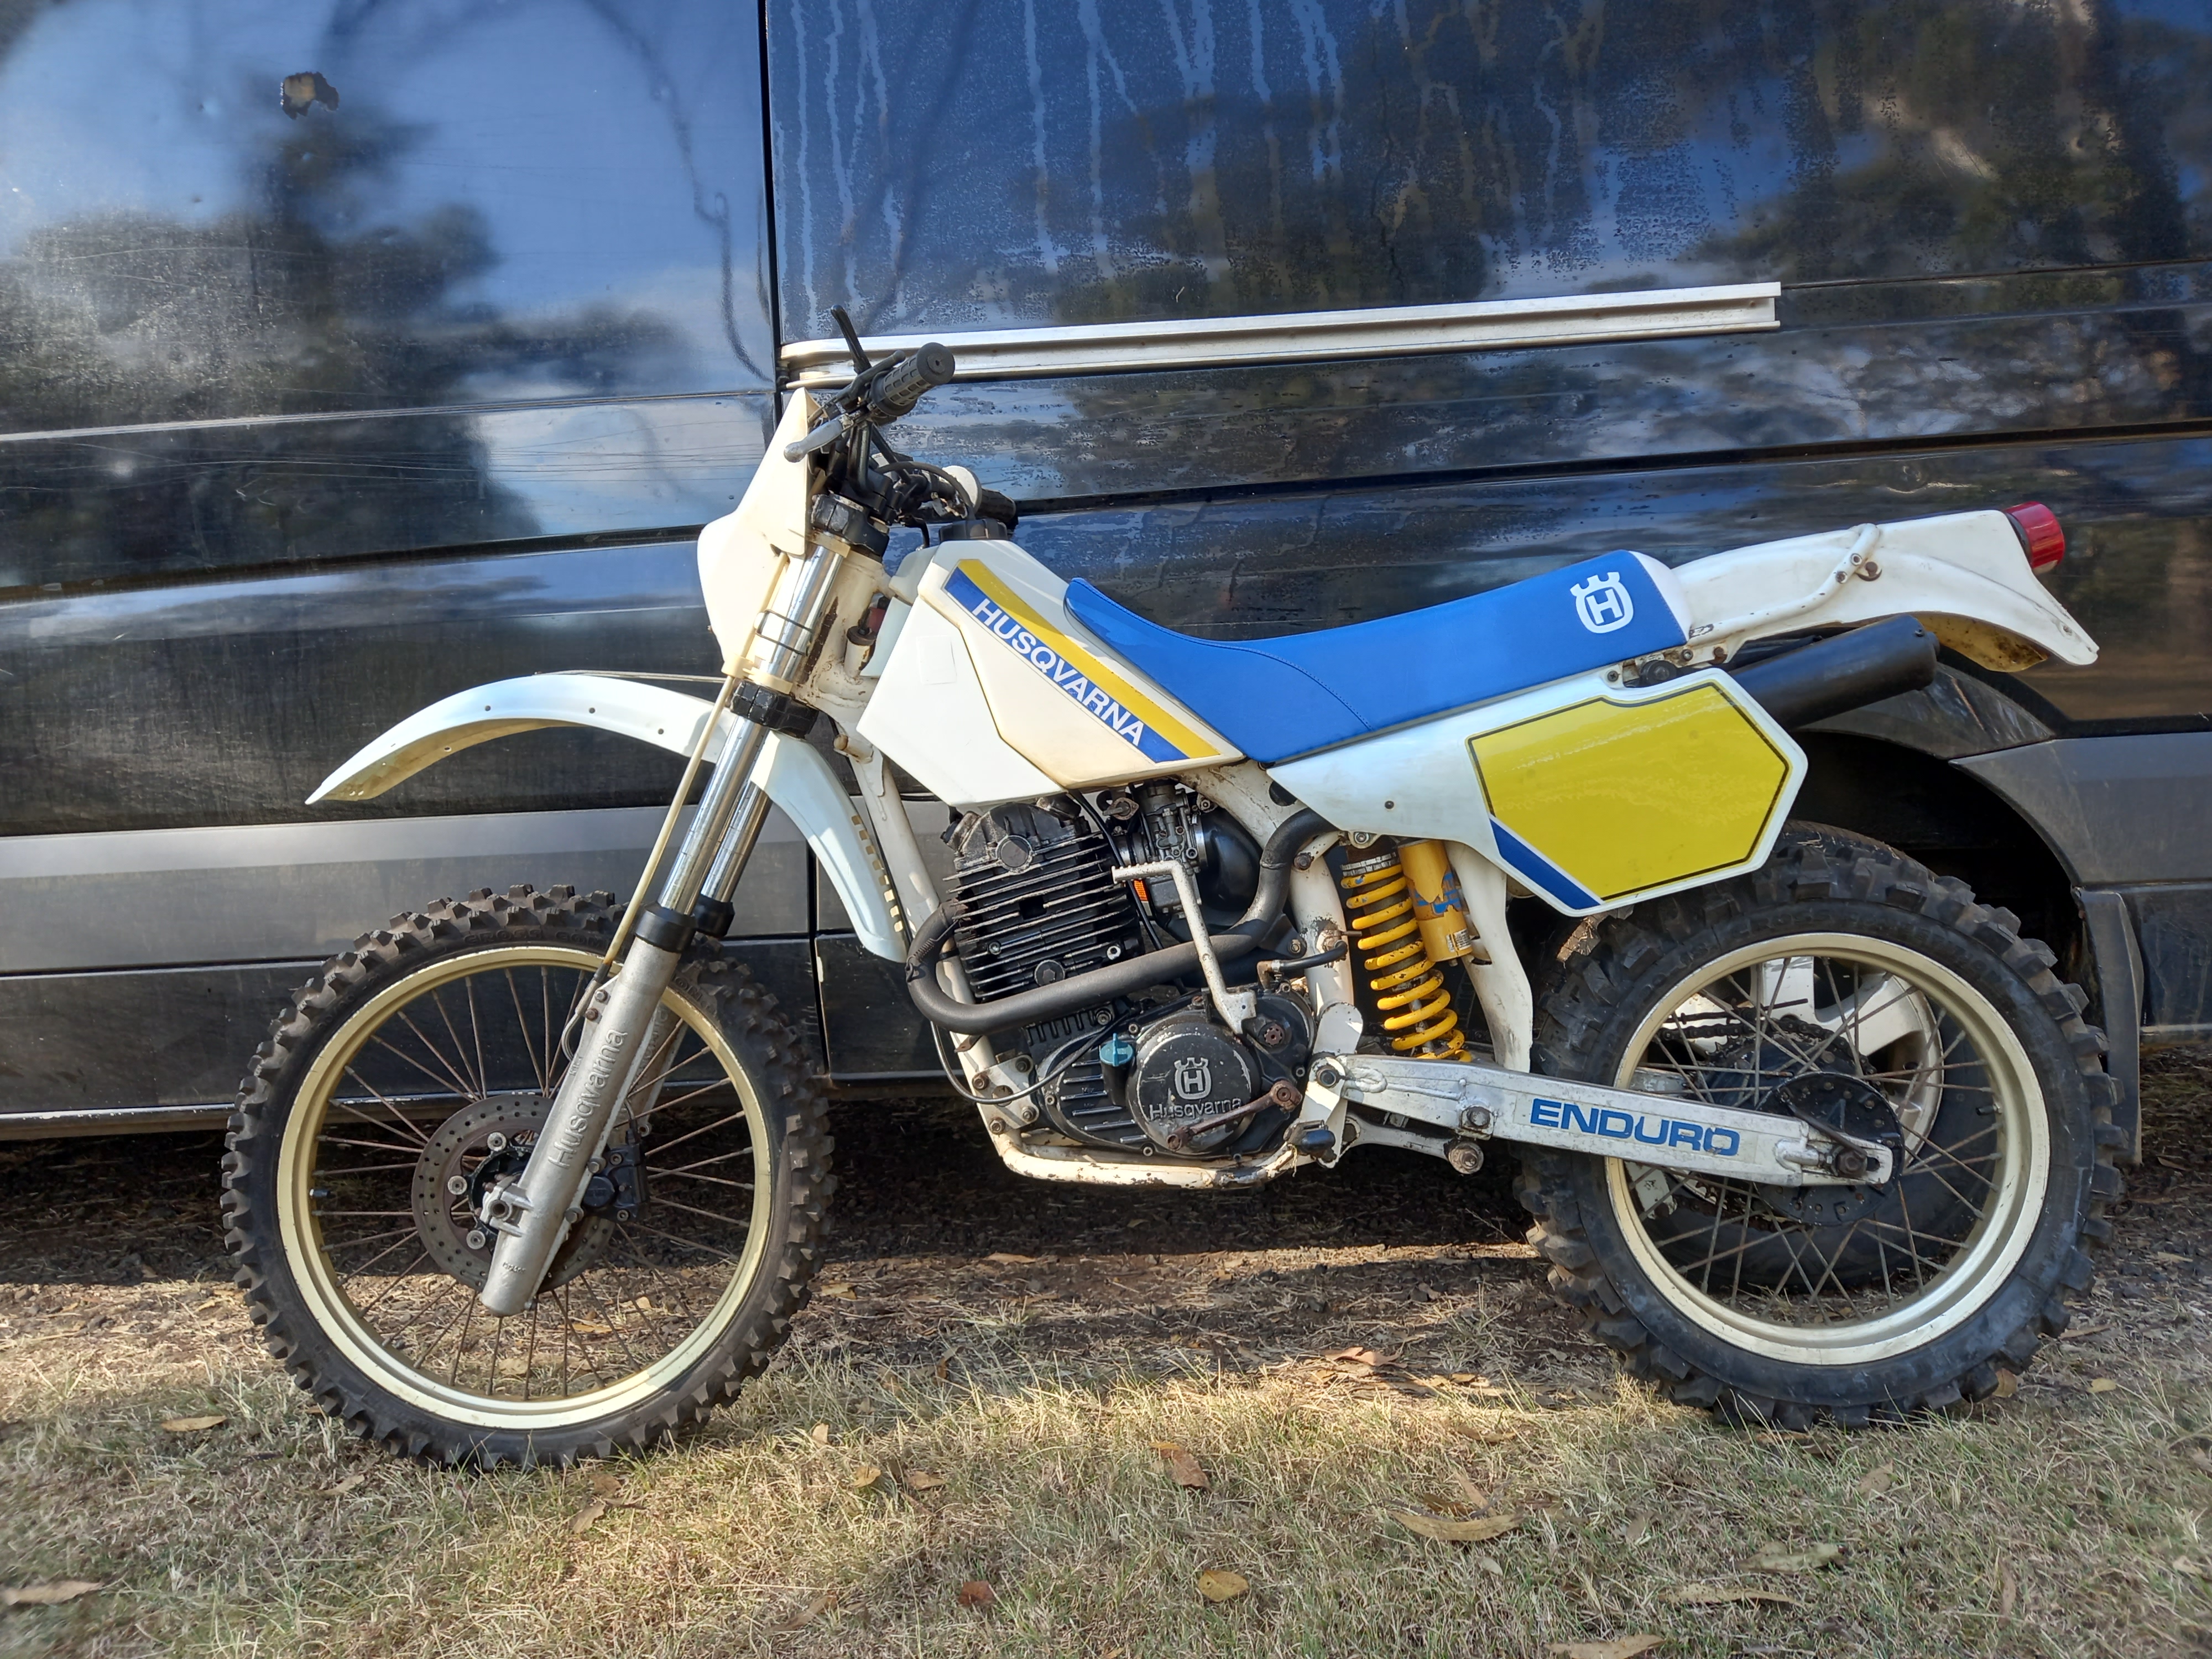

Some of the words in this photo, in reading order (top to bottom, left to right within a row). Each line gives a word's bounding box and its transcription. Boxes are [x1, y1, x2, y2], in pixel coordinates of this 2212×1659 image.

[973, 598, 1144, 746] HUSQVARNA
[548, 1029, 628, 1170] Husqvarna
[1149, 1098, 1242, 1121] Husqvarna
[1530, 1098, 1740, 1156] ENDURO
